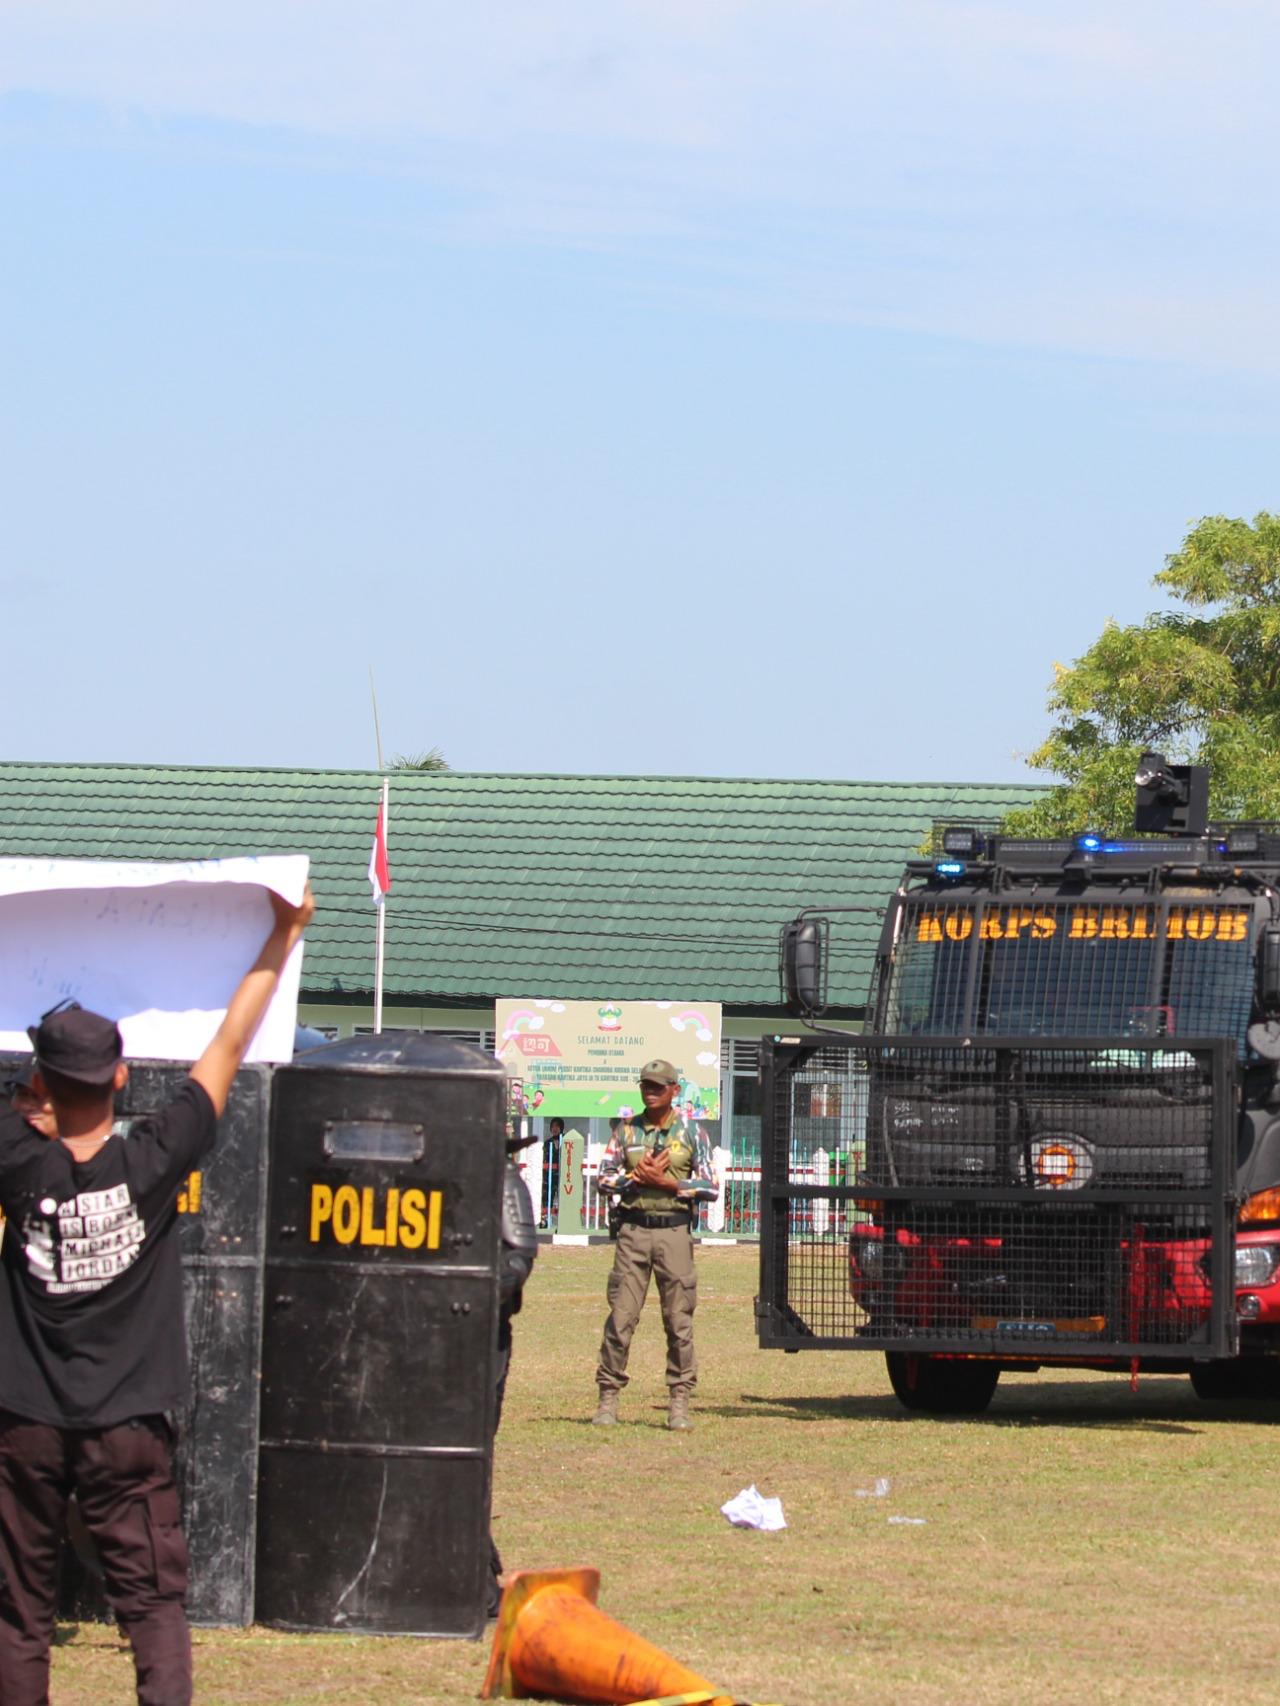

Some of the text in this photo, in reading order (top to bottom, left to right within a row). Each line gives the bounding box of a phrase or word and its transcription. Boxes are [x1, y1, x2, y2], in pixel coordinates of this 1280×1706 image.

[916, 908, 1248, 942] KORPS BRIMOB
[577, 1035, 611, 1045] SELAMAT
[81, 1188, 127, 1213] STAR
[310, 1184, 442, 1249] POLISI
